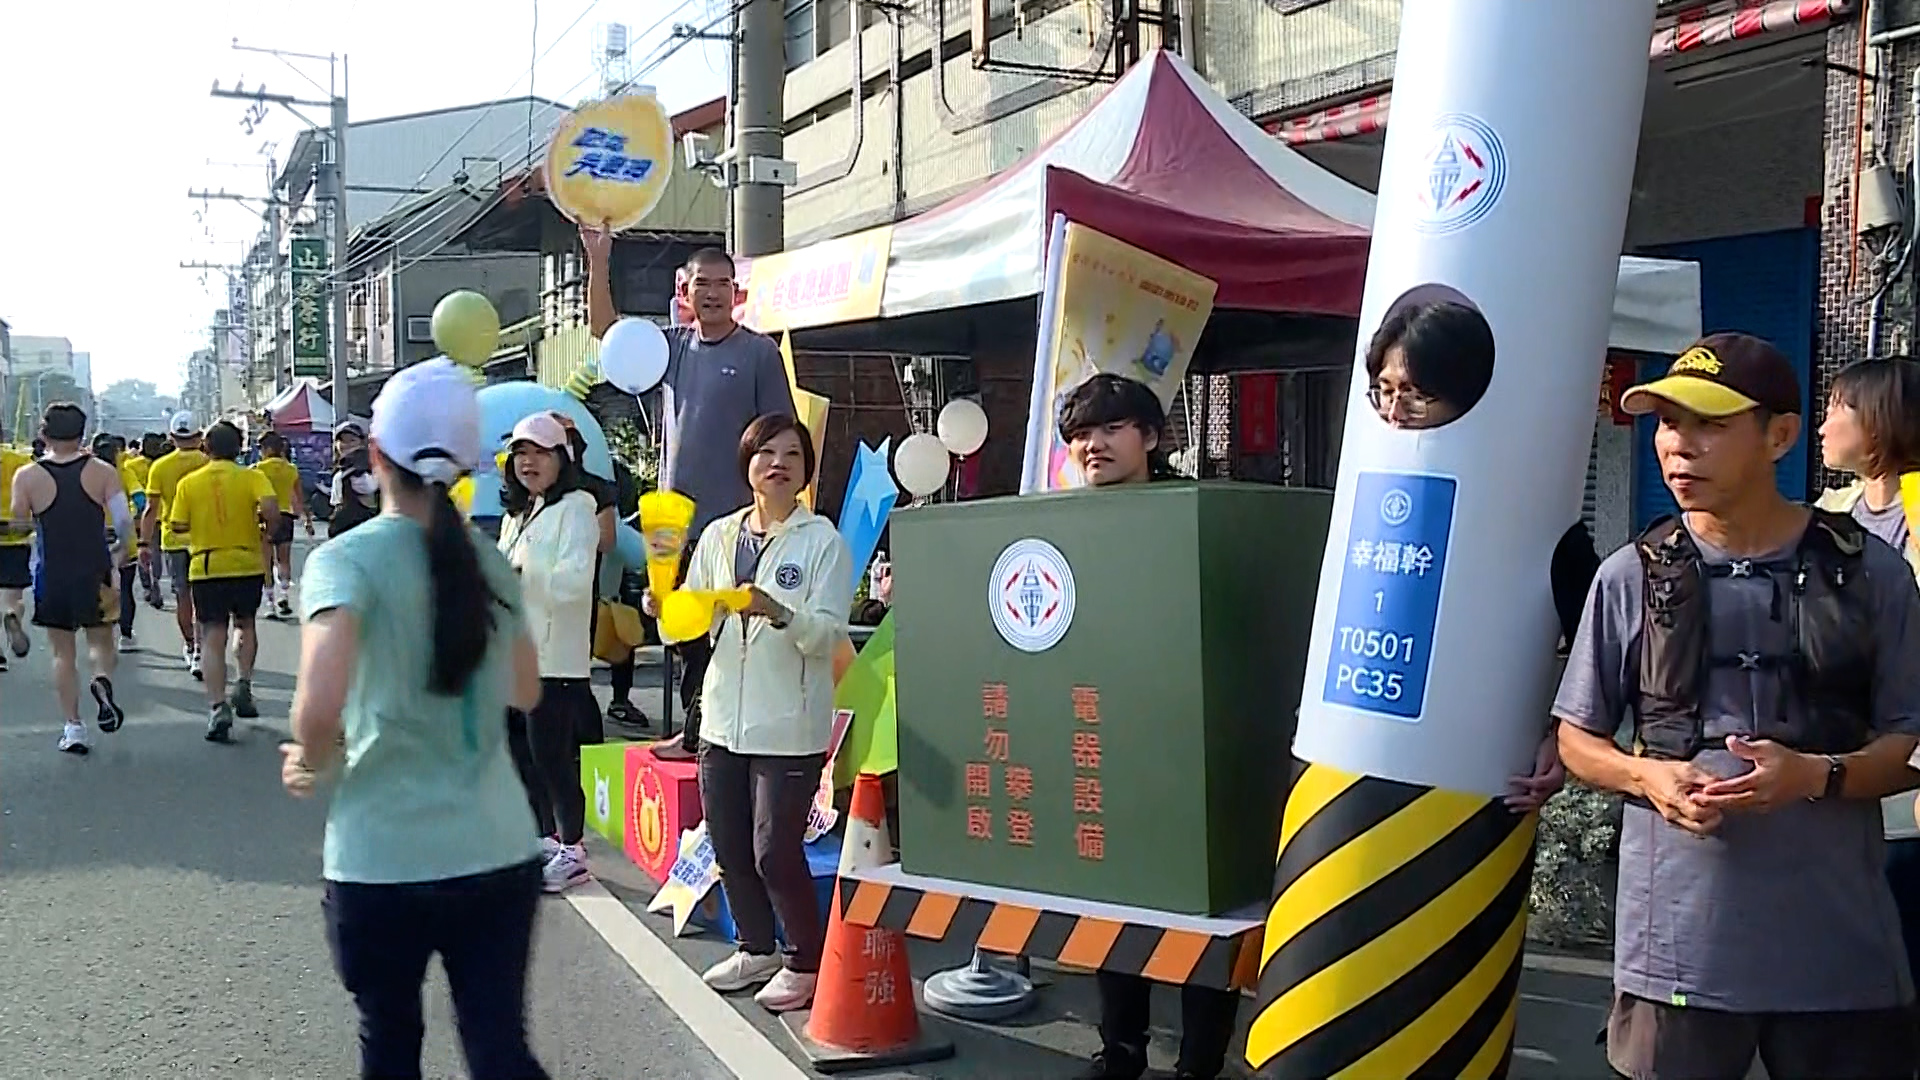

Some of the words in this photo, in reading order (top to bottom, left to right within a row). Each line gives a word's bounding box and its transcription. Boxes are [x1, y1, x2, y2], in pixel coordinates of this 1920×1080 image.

[1351, 538, 1434, 577] 幸福幹
[1374, 591, 1384, 613] 1
[1339, 626, 1415, 663] T0501
[1335, 663, 1404, 701] PC35
[981, 682, 1009, 761] 請勿
[1071, 684, 1105, 860] 電器設備
